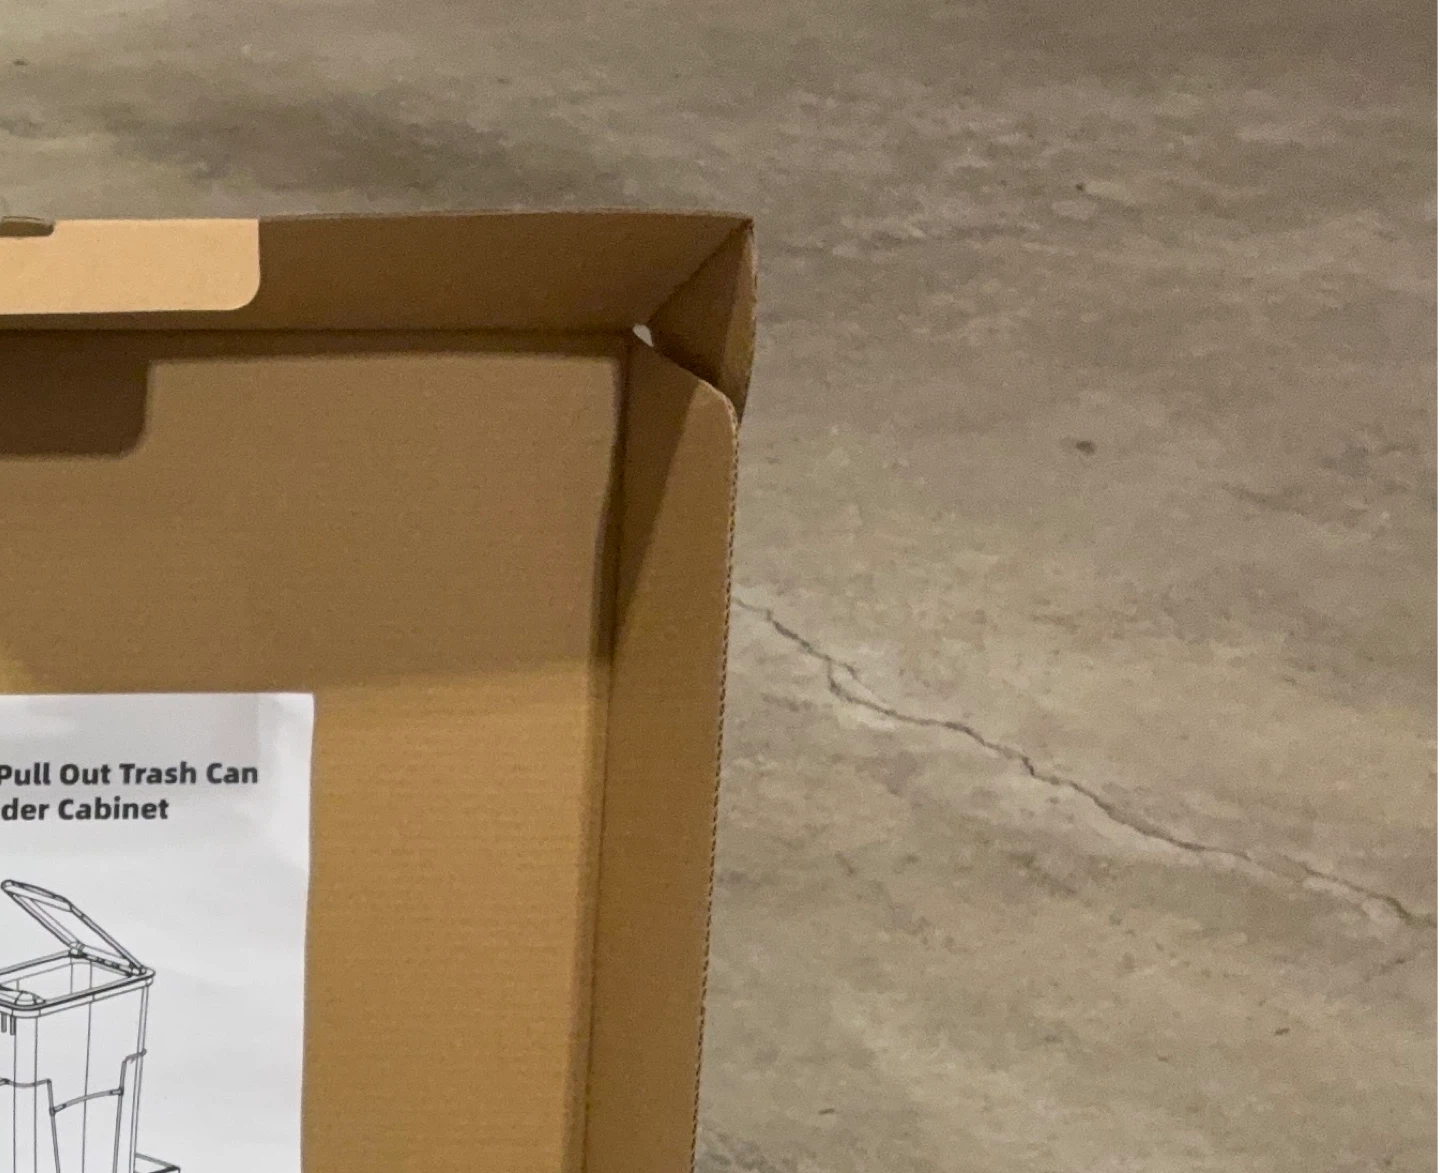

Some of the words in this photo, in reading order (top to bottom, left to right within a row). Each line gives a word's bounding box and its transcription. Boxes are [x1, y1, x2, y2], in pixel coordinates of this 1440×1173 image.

[59, 762, 112, 787] Out
[119, 759, 197, 786] Trash
[206, 761, 258, 786] Can
[58, 794, 169, 821] Cabinet
